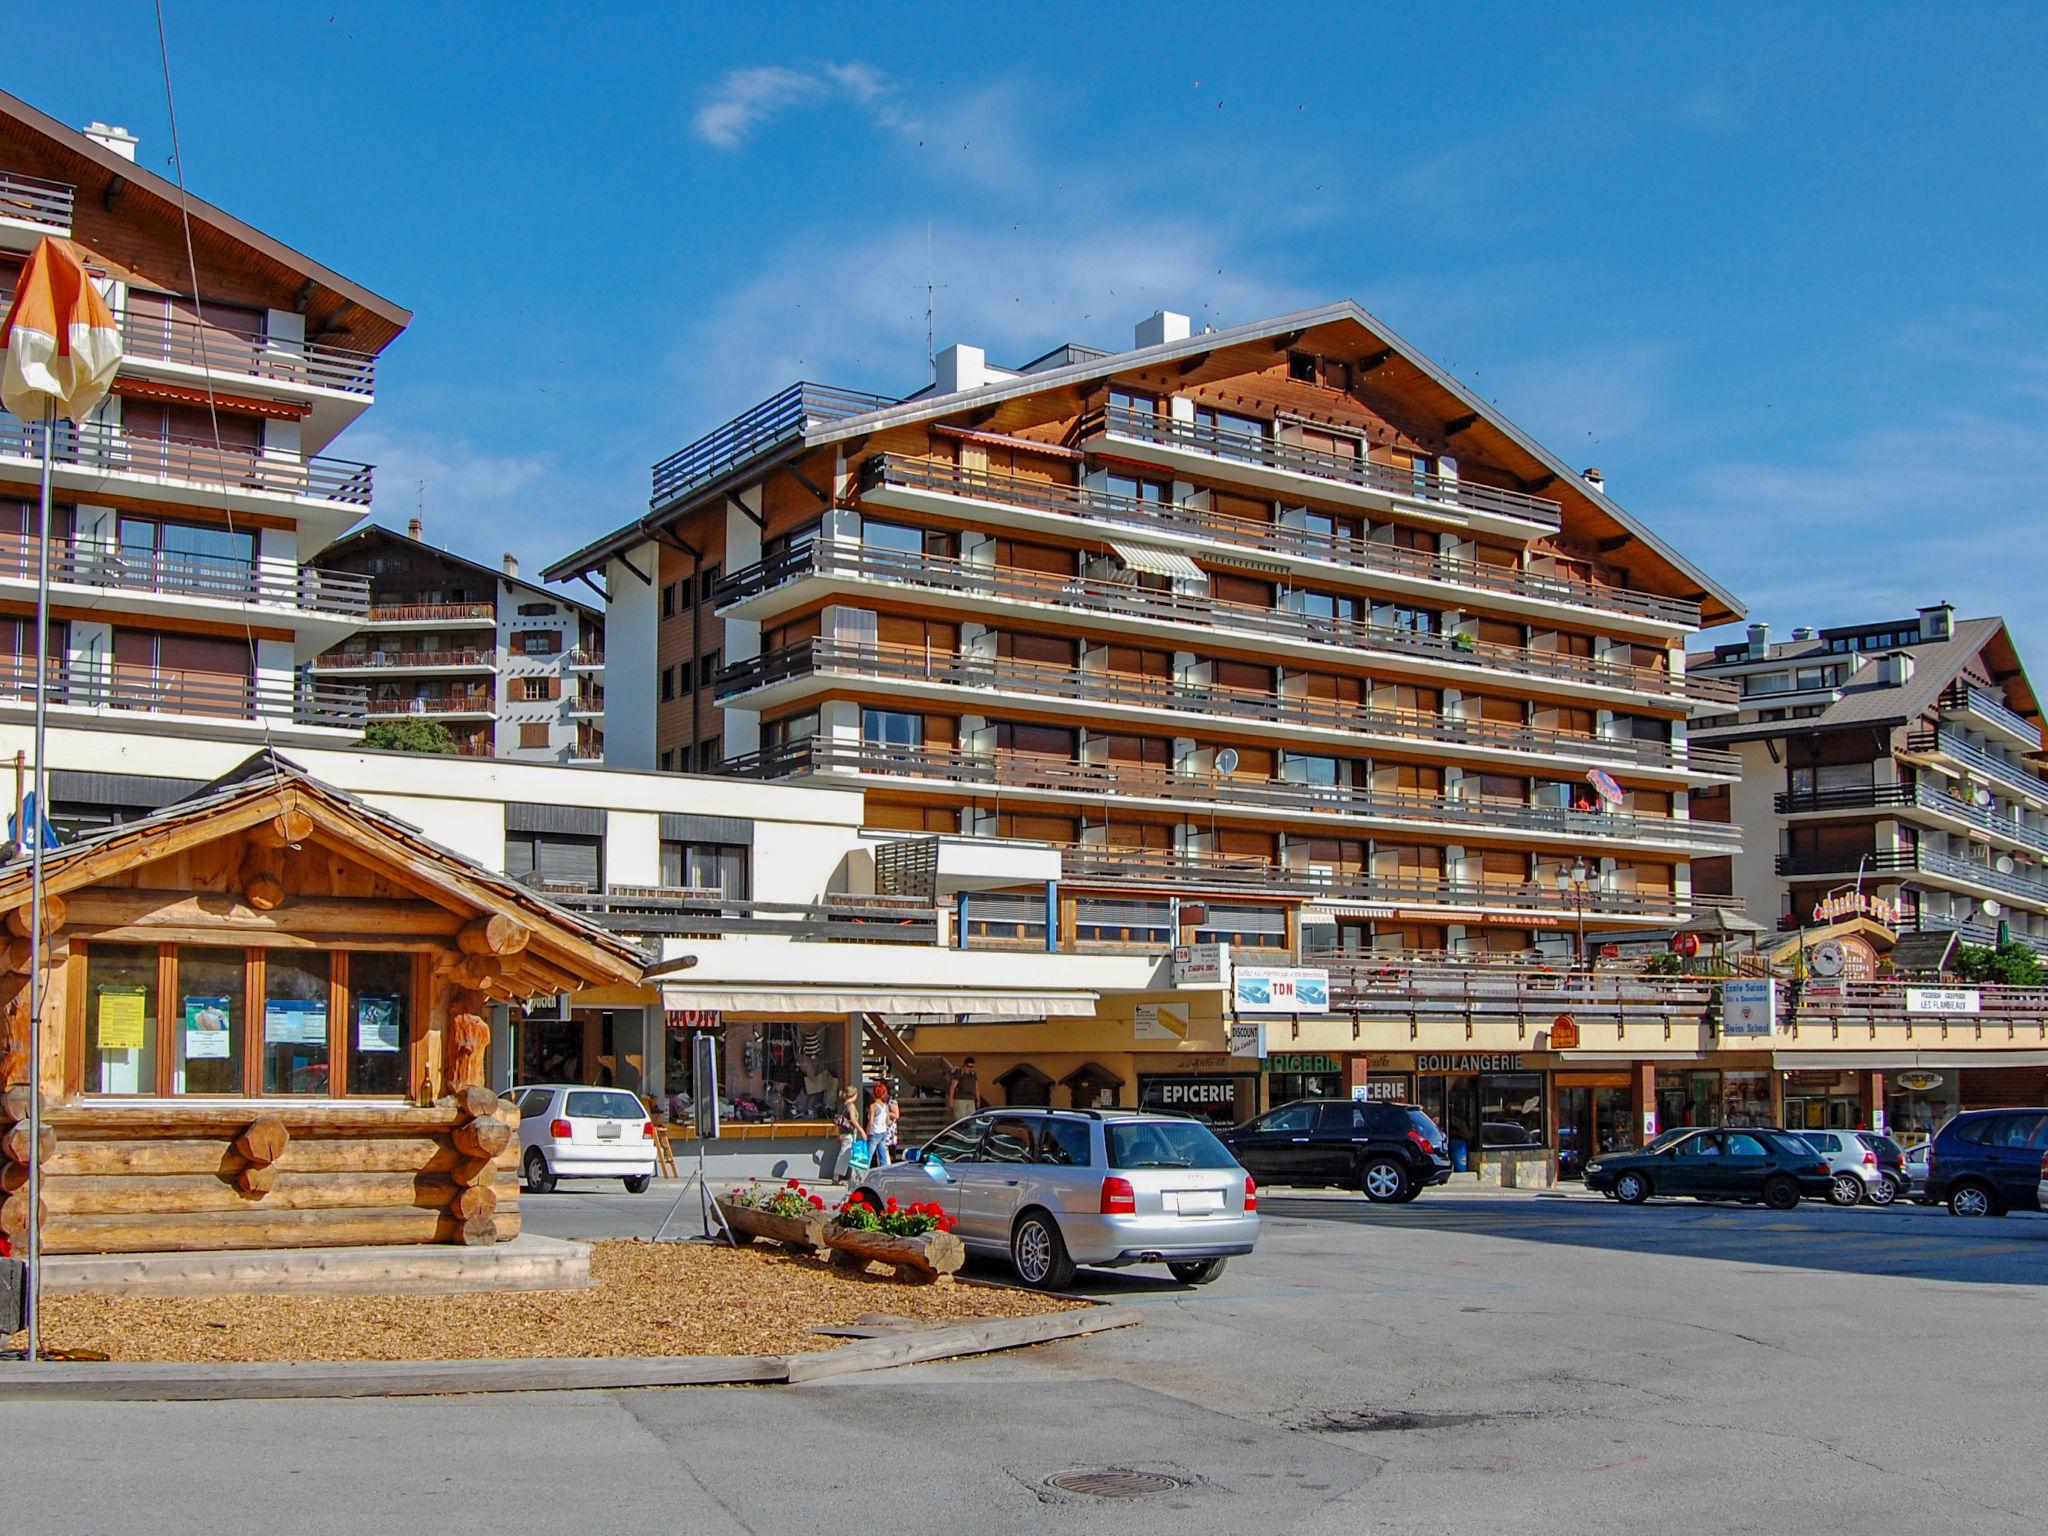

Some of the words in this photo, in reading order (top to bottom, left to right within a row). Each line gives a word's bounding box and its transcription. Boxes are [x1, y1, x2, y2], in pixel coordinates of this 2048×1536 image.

[1745, 983, 1767, 992] Suisse
[1921, 1000, 1931, 1009] LES
[1232, 1027, 1258, 1038] DISCOUNT
[1747, 1023, 1769, 1033] School
[1262, 1055, 1341, 1072] EPICERIE
[1418, 1054, 1523, 1071] BOULANGERIE
[1163, 1085, 1235, 1103] EPICERIE
[1367, 1082, 1405, 1099] CERIE
